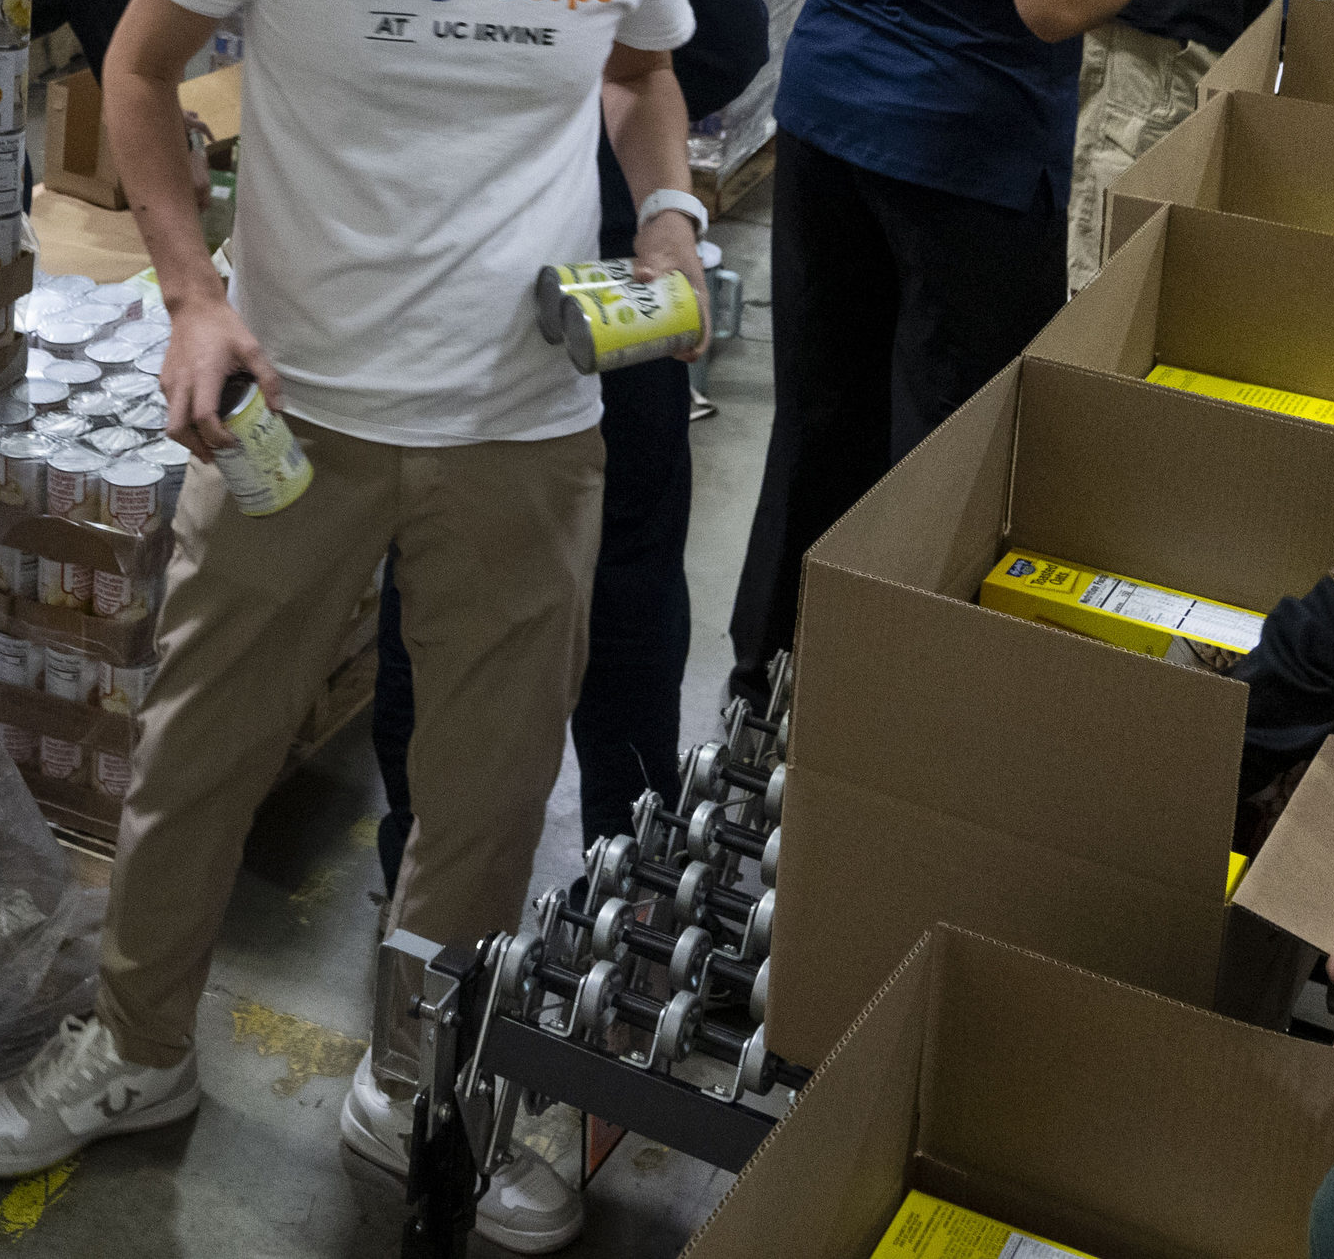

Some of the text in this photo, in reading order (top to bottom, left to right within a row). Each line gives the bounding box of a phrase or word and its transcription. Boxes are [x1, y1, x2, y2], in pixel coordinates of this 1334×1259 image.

[375, 17, 558, 45] AT UC IRVINE
[1030, 564, 1059, 587] Toasted
